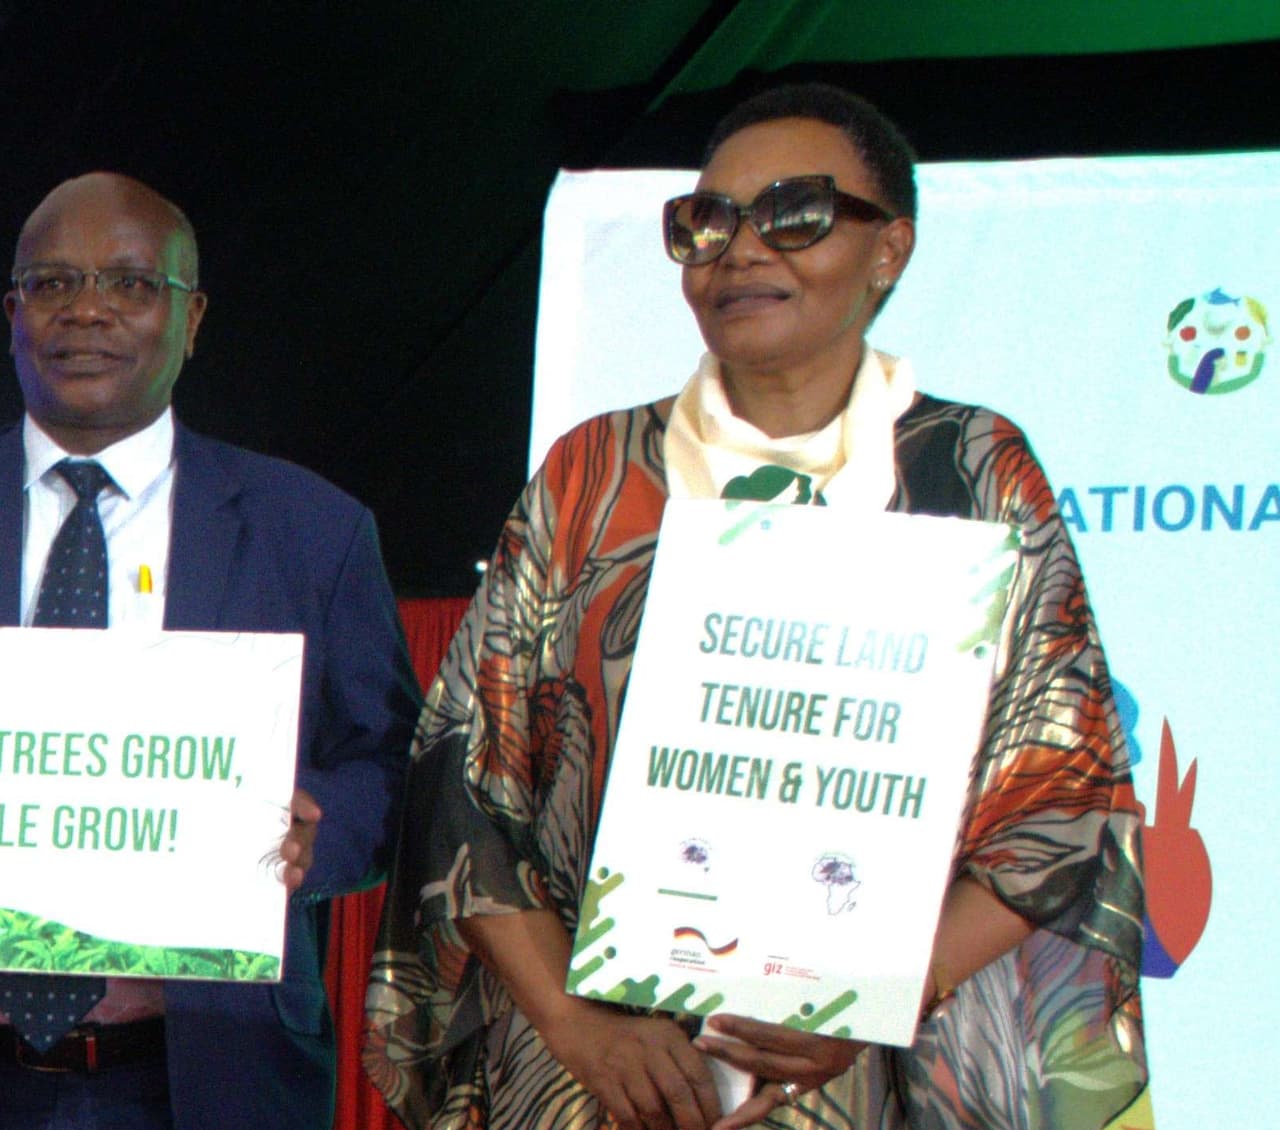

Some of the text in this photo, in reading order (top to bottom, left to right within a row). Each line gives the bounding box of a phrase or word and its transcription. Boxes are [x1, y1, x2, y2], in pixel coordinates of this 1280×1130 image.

[699, 612, 929, 674] SECURE LAND
[699, 682, 902, 744] TENURE FOR
[120, 733, 245, 788] GROW,
[646, 745, 928, 819] WOMEN & YOUTH
[51, 805, 178, 852] GROW!
